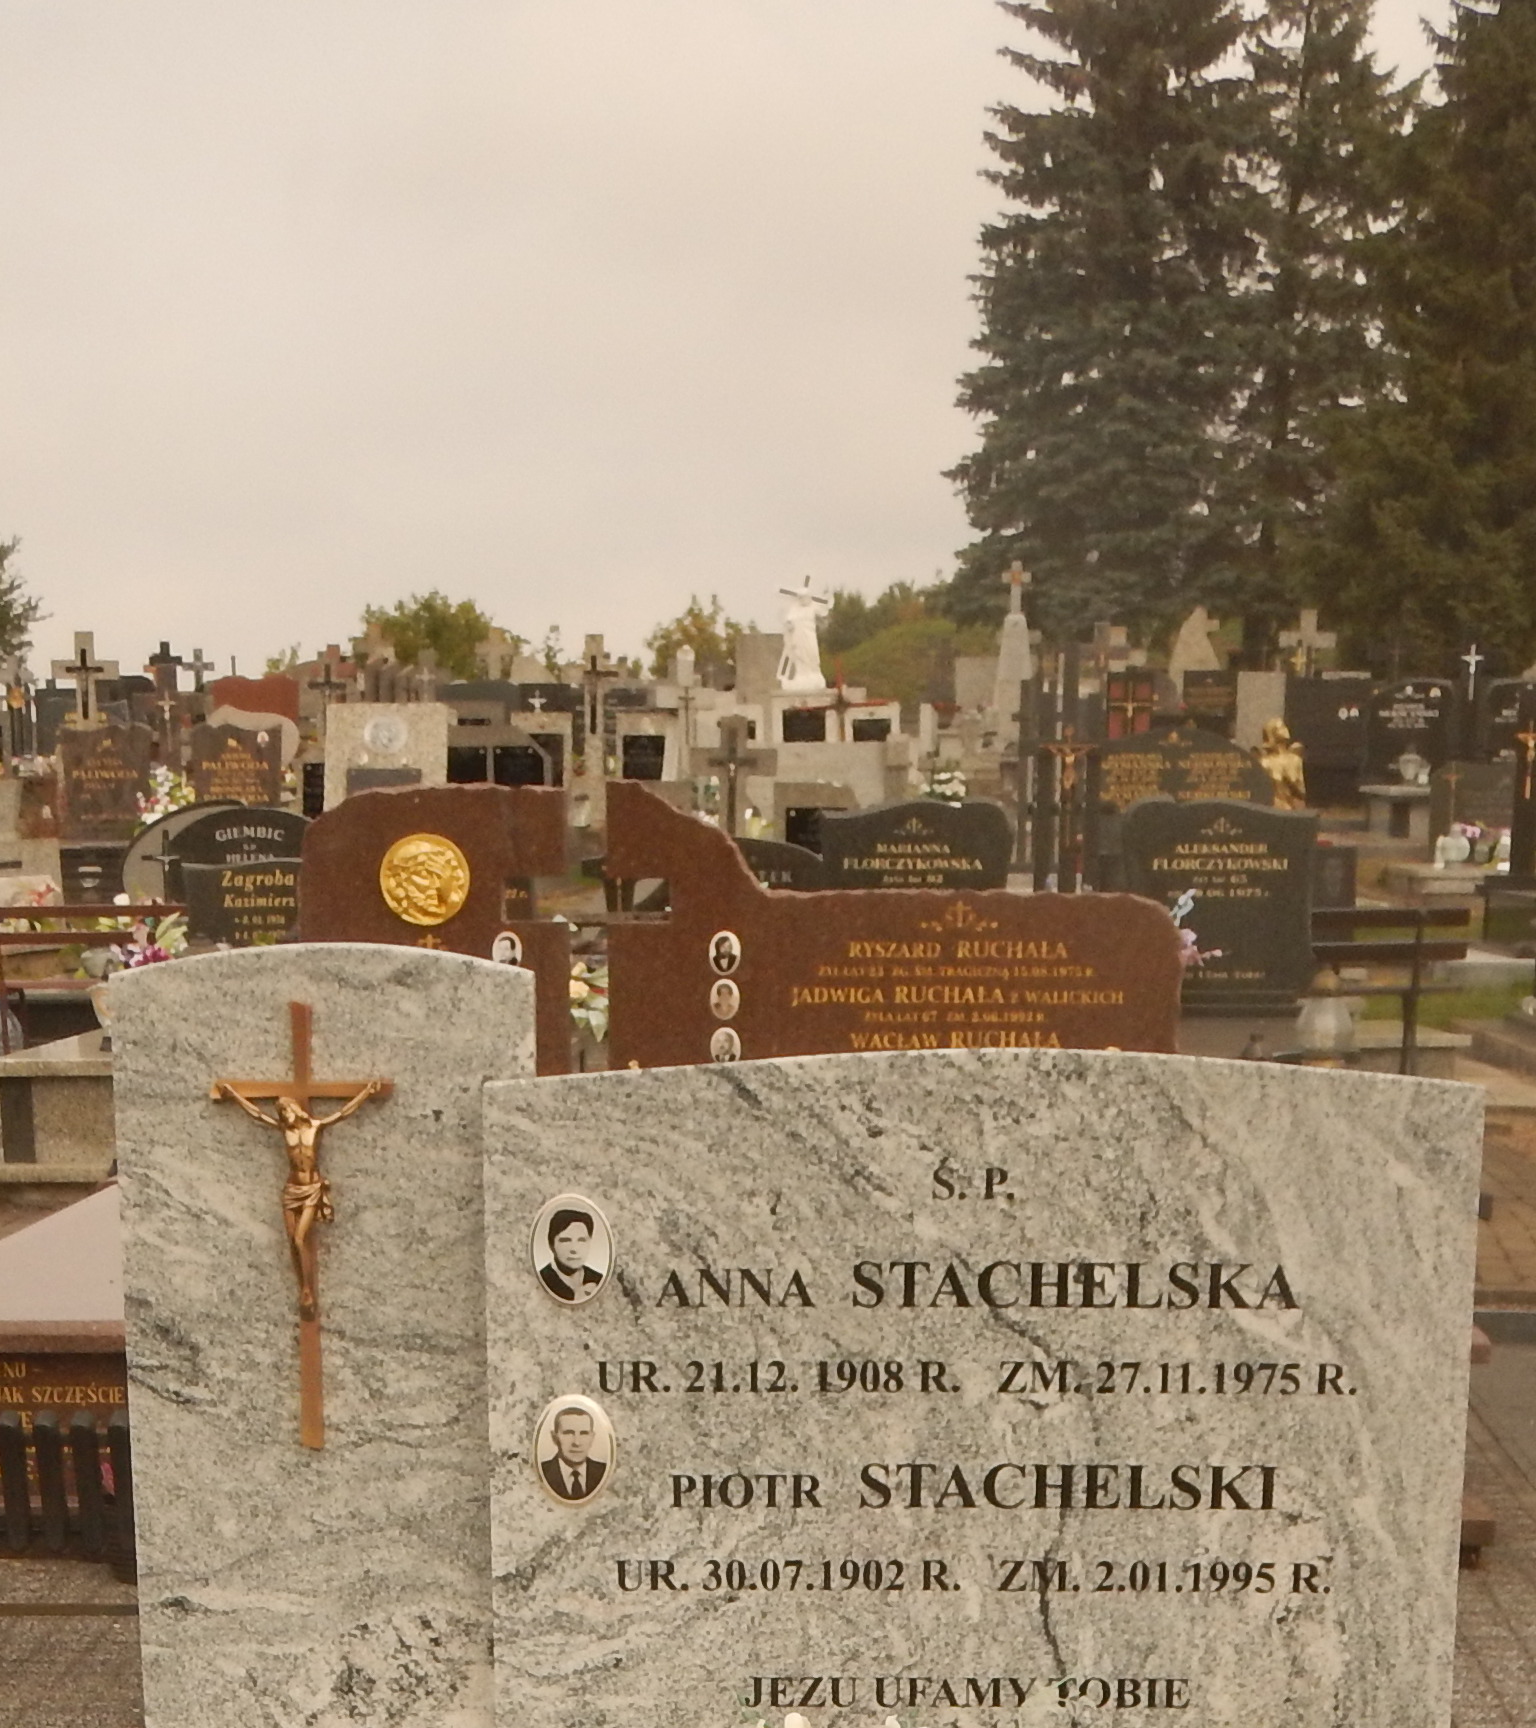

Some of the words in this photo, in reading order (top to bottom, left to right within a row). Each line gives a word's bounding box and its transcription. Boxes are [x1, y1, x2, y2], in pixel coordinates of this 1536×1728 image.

[221, 869, 295, 892] Zagroba
[849, 940, 942, 960] RYSZARD
[956, 940, 1069, 960] RUCHAŁA
[791, 986, 885, 1007] JADWIGA
[894, 985, 1006, 1005] RUCHAŁA
[849, 1032, 939, 1050] WACŁAW
[949, 1031, 1063, 1049] RUCHAŁA
[984, 1166, 1016, 1200] P.
[655, 1268, 816, 1309] ANNA
[851, 1260, 1301, 1310] STACHELSKA
[31, 1381, 127, 1407] SZCZĘŚCIE
[597, 1359, 672, 1394] UR.
[685, 1360, 800, 1394] 21.12.
[816, 1360, 905, 1394] 1908
[918, 1360, 962, 1394] R.
[996, 1360, 1083, 1395] ZM.
[1096, 1360, 1302, 1396] 27.11.1975
[1316, 1362, 1358, 1397] R.
[670, 1473, 823, 1510] PIOTR
[858, 1462, 1279, 1511] STACHELSKI
[615, 1558, 690, 1593] UR.
[702, 1558, 905, 1593] 30.07.1902
[921, 1558, 962, 1593] R.
[996, 1559, 1081, 1594] ZM.
[1095, 1560, 1277, 1595] 2.01.1995
[1291, 1562, 1332, 1596] R.
[744, 1676, 859, 1709] JEZU
[874, 1676, 1038, 1709] UFAMY
